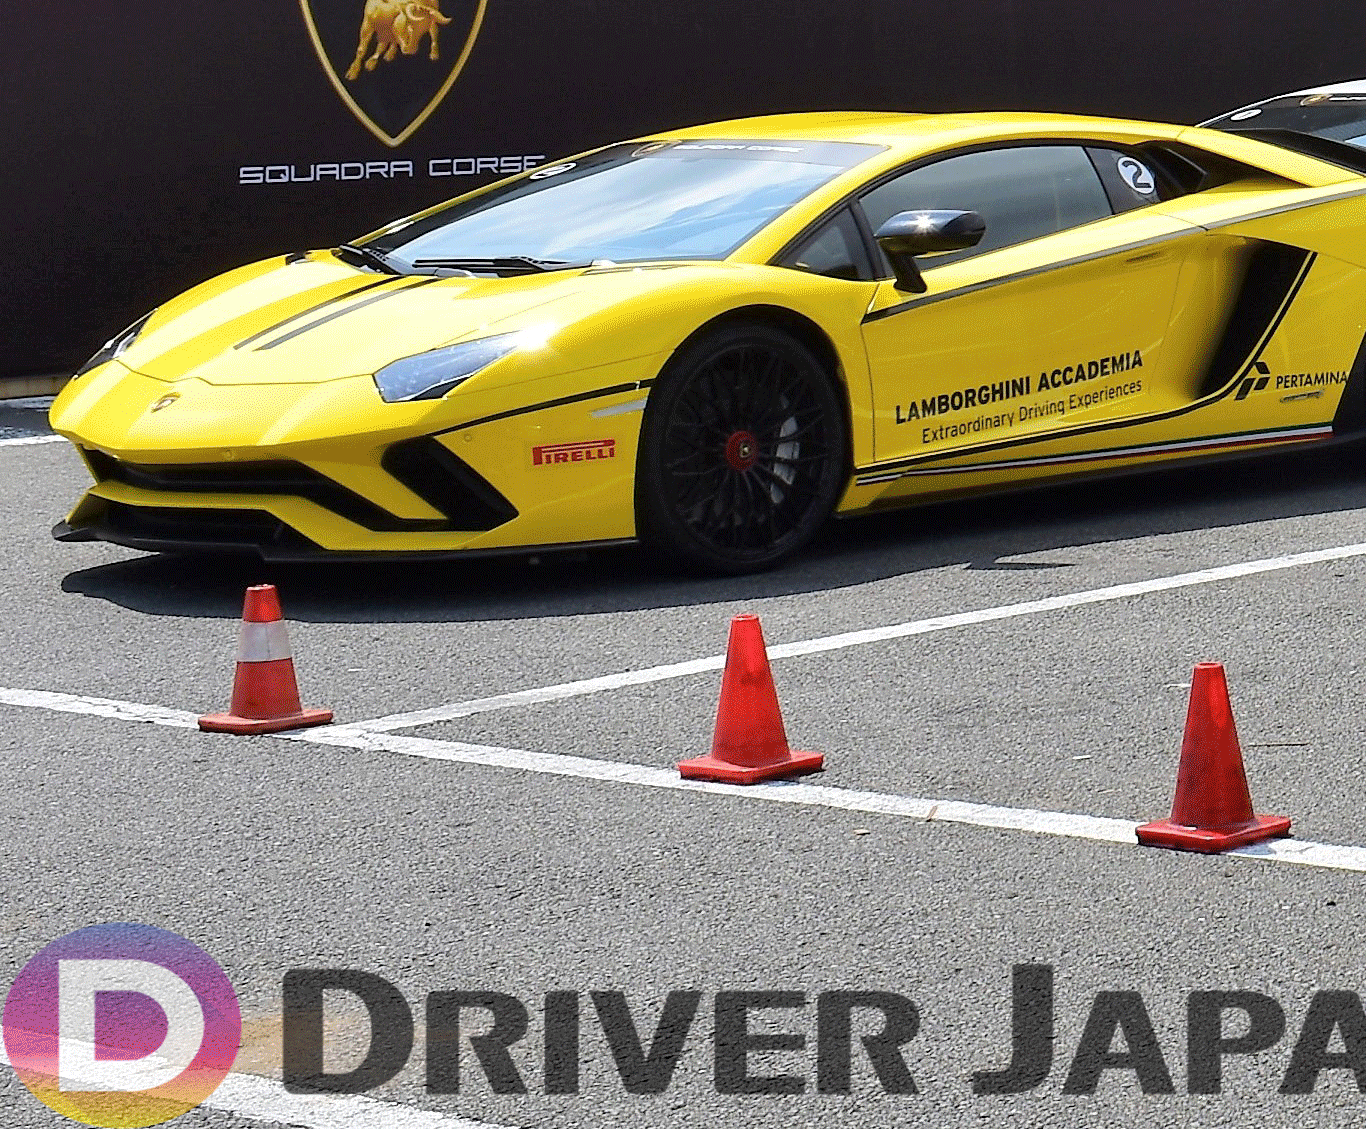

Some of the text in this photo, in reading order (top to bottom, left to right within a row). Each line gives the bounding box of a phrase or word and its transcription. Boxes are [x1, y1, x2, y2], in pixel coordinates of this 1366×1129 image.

[239, 160, 414, 184] SQUADRA
[1121, 160, 1152, 189] 2
[896, 349, 1144, 425] LAMBORGHINI ACCADEMIA
[1276, 370, 1348, 390] PERTAMINA
[922, 379, 1143, 445] Extraordinary Driving Experiences
[532, 439, 616, 466] PIRELLI
